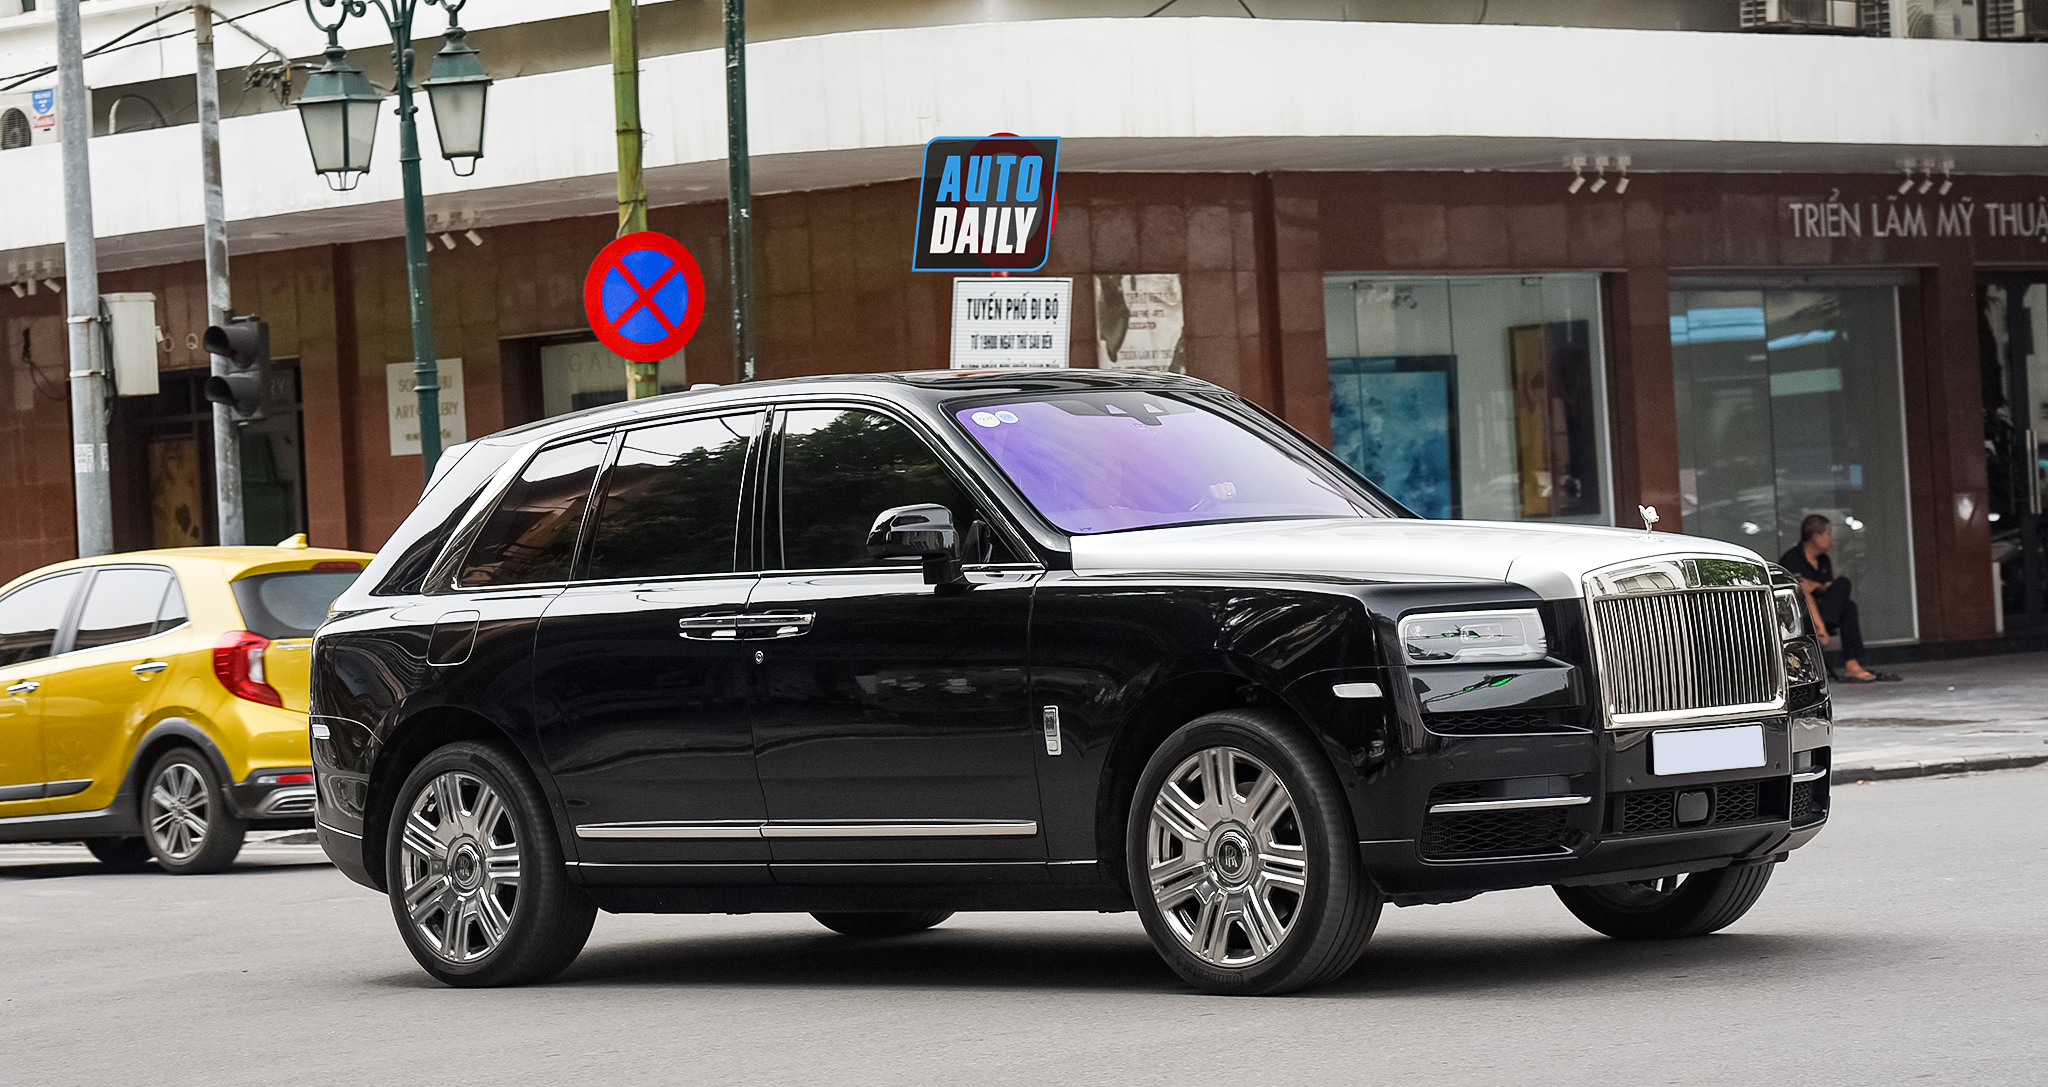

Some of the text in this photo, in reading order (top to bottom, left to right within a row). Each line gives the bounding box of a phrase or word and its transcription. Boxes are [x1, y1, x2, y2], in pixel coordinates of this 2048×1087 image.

[1789, 187, 1861, 238] TRIỂN
[1872, 195, 1928, 238] LÃM
[1937, 196, 1975, 237] MỸ
[967, 291, 1002, 320] TUYẾN
[1006, 291, 1030, 320] PHỐ
[1045, 293, 1059, 325] BỘ
